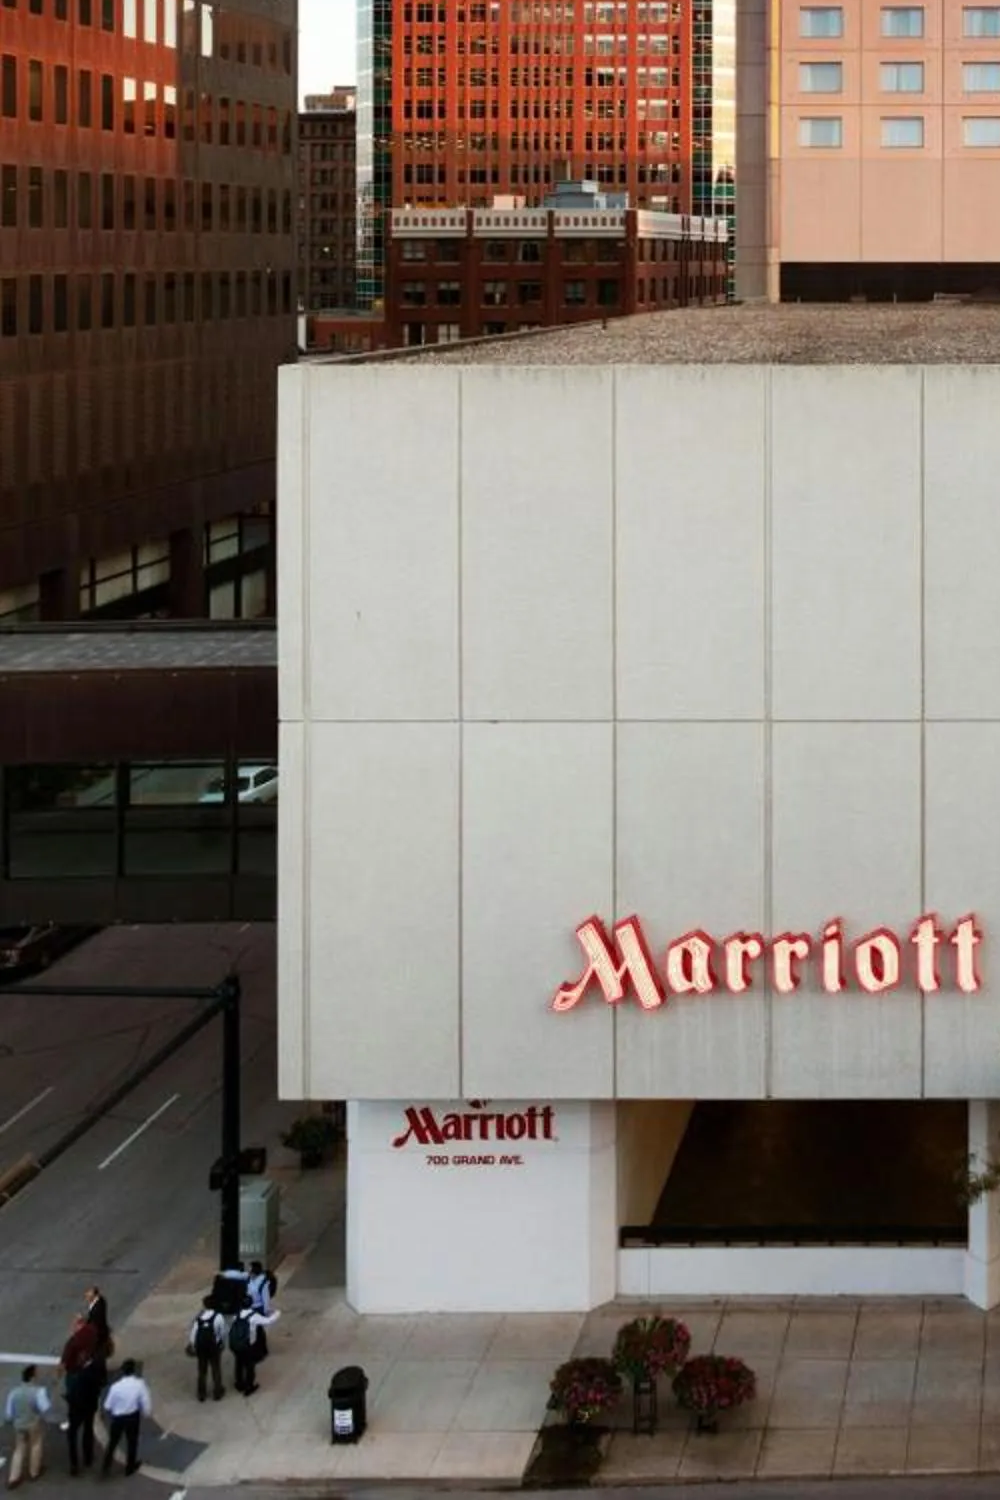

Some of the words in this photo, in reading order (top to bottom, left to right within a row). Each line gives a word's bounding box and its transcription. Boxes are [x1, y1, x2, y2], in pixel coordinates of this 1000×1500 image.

[550, 912, 983, 1011] Marriott
[392, 1105, 555, 1148] Marriott
[425, 1155, 449, 1165] 700
[452, 1155, 495, 1165] GRAND
